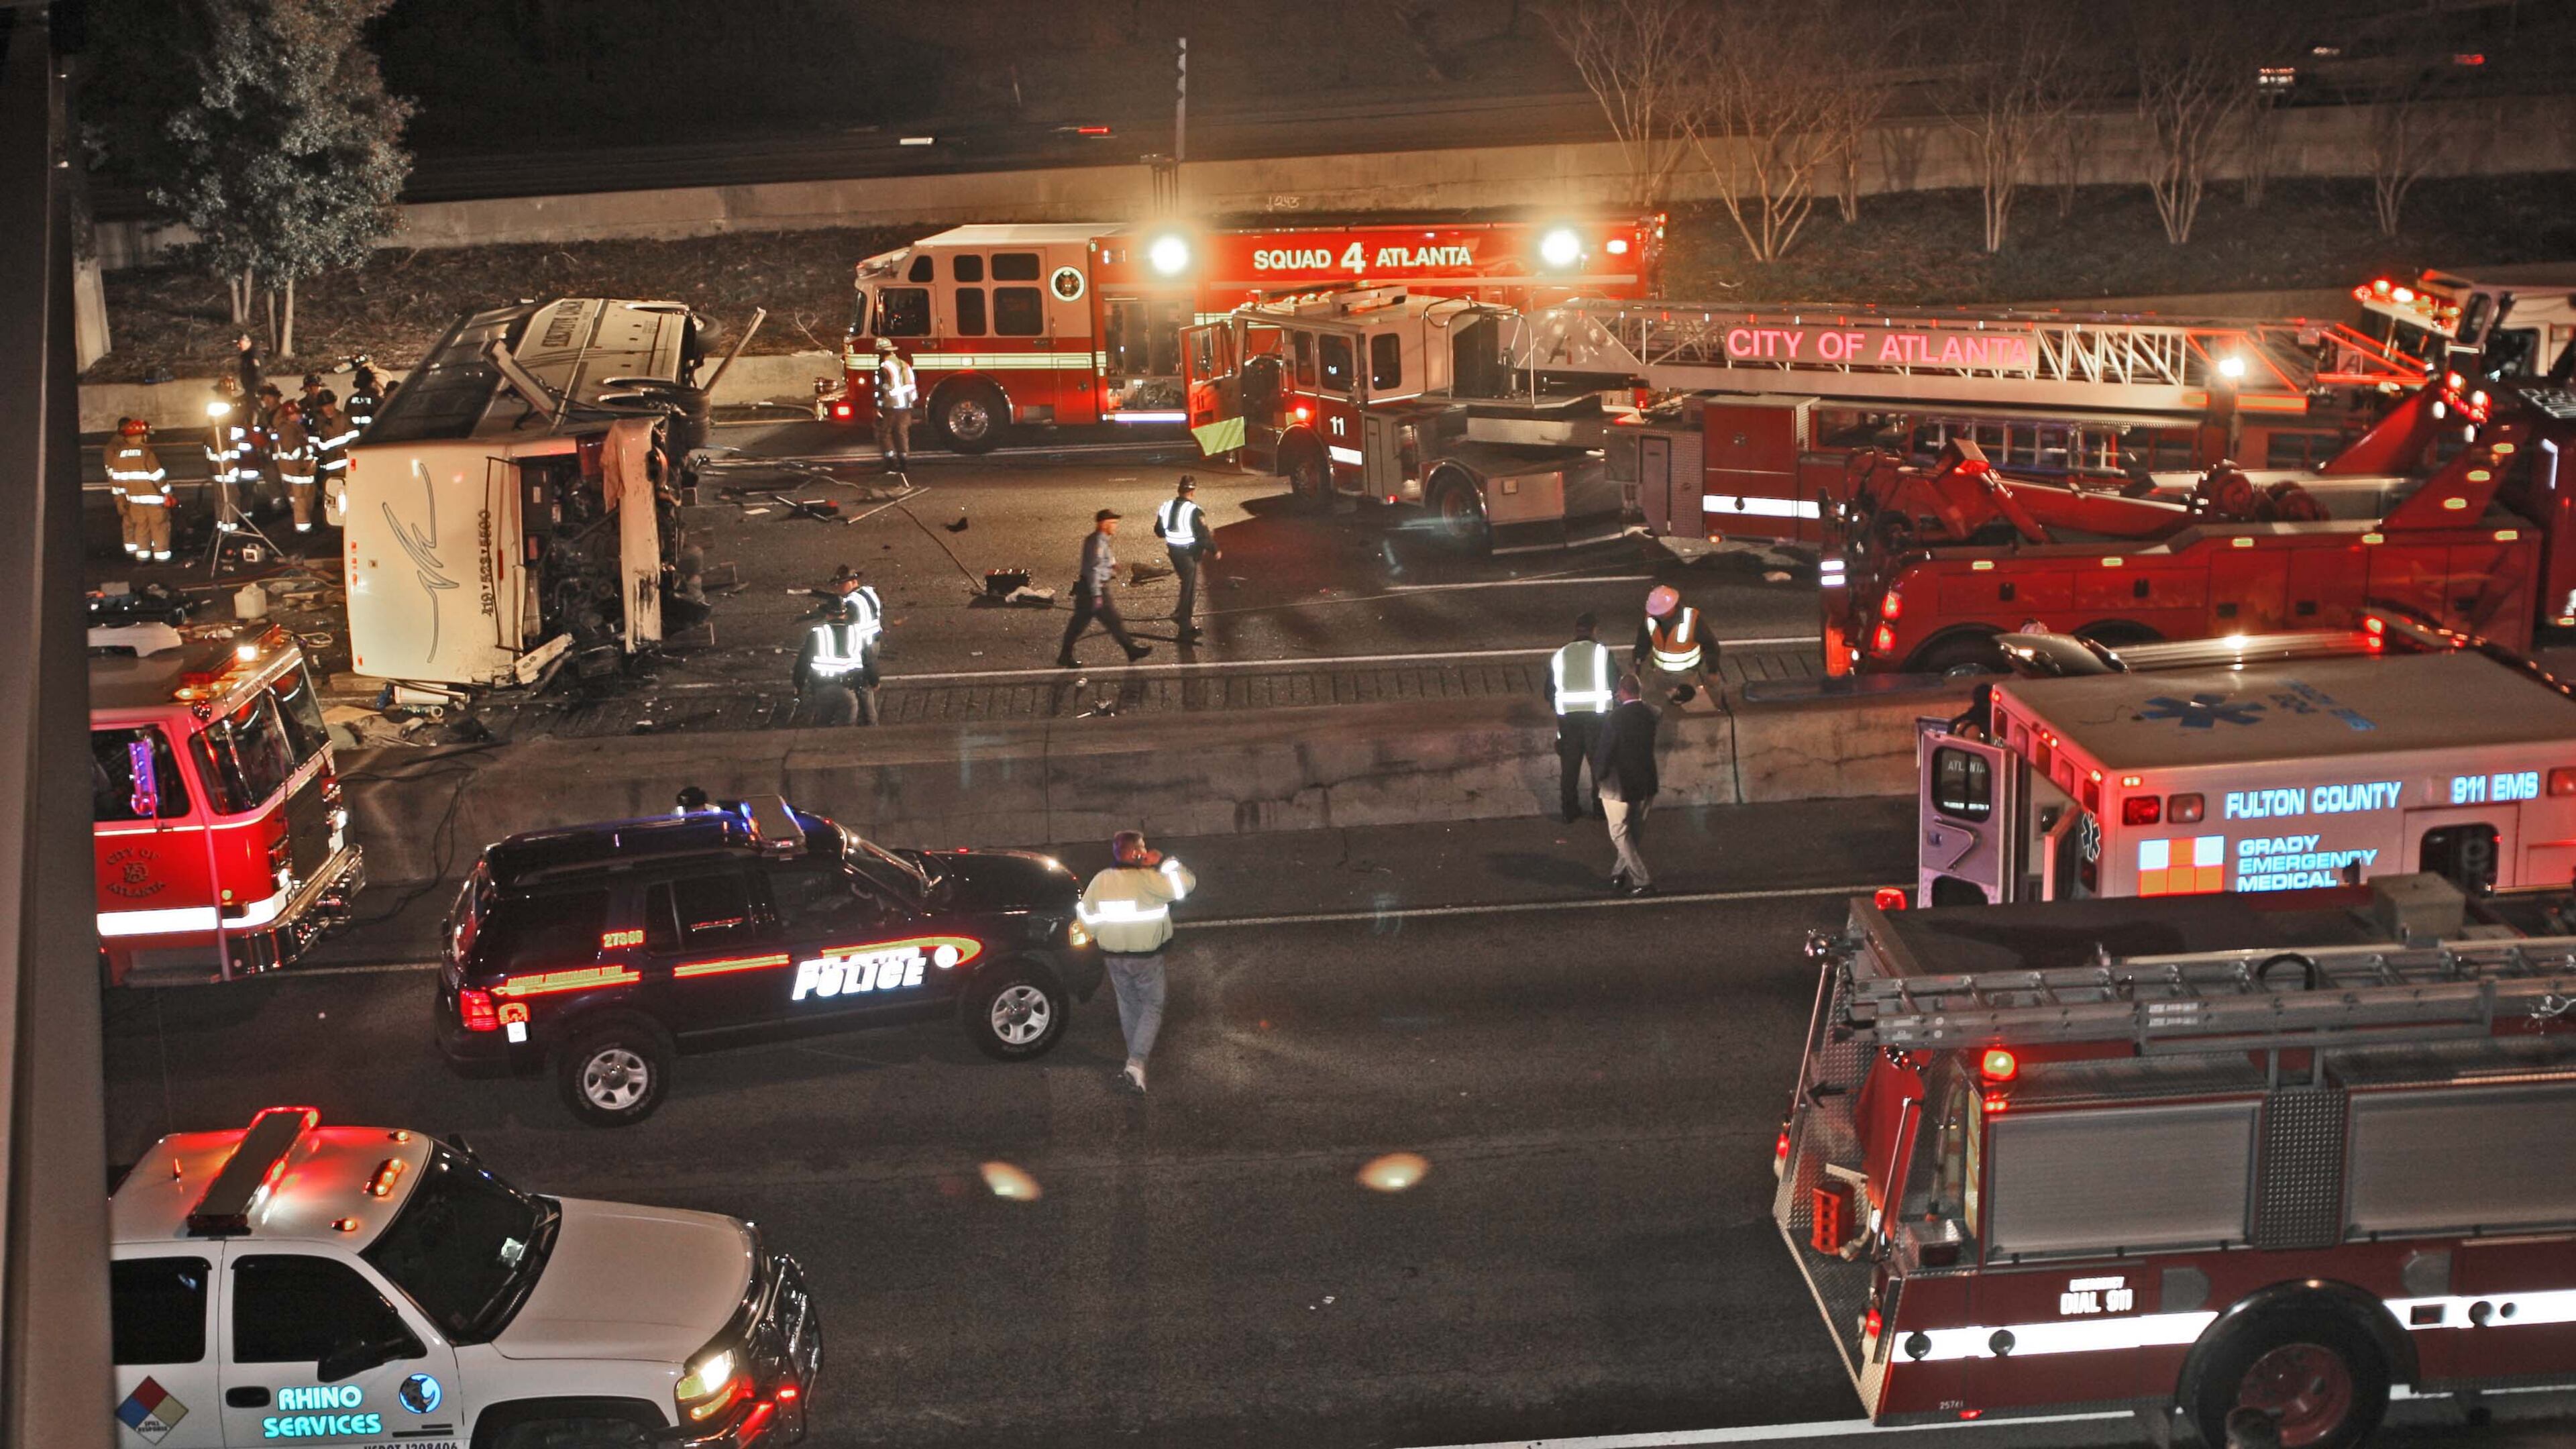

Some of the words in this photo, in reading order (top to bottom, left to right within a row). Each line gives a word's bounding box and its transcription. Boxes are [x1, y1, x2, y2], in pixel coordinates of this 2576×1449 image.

[1253, 249, 1332, 270] SQUAD
[1340, 241, 1366, 274] 4
[1375, 246, 1472, 268] ATLANTA
[1727, 328, 1804, 358] CITY
[1817, 331, 1865, 360] OF
[1878, 333, 2031, 366] ATLANTA
[1330, 415, 1345, 437] 11
[1947, 759, 1986, 774] ATLNTA
[2225, 788, 2306, 820] FULTON
[2312, 780, 2402, 815] COUNTY
[2451, 774, 2487, 804] 911
[2491, 771, 2539, 802] EMS
[2239, 834, 2320, 857] GRADY
[2238, 849, 2378, 875] EMERGENCY
[2237, 869, 2337, 893] MEDICAL
[792, 953, 927, 1002] POLICE
[2059, 1291, 2102, 1315] DIAL
[2106, 1288, 2133, 1312] 911
[278, 1384, 362, 1411] RHINO
[262, 1412, 382, 1438] SERVICES
